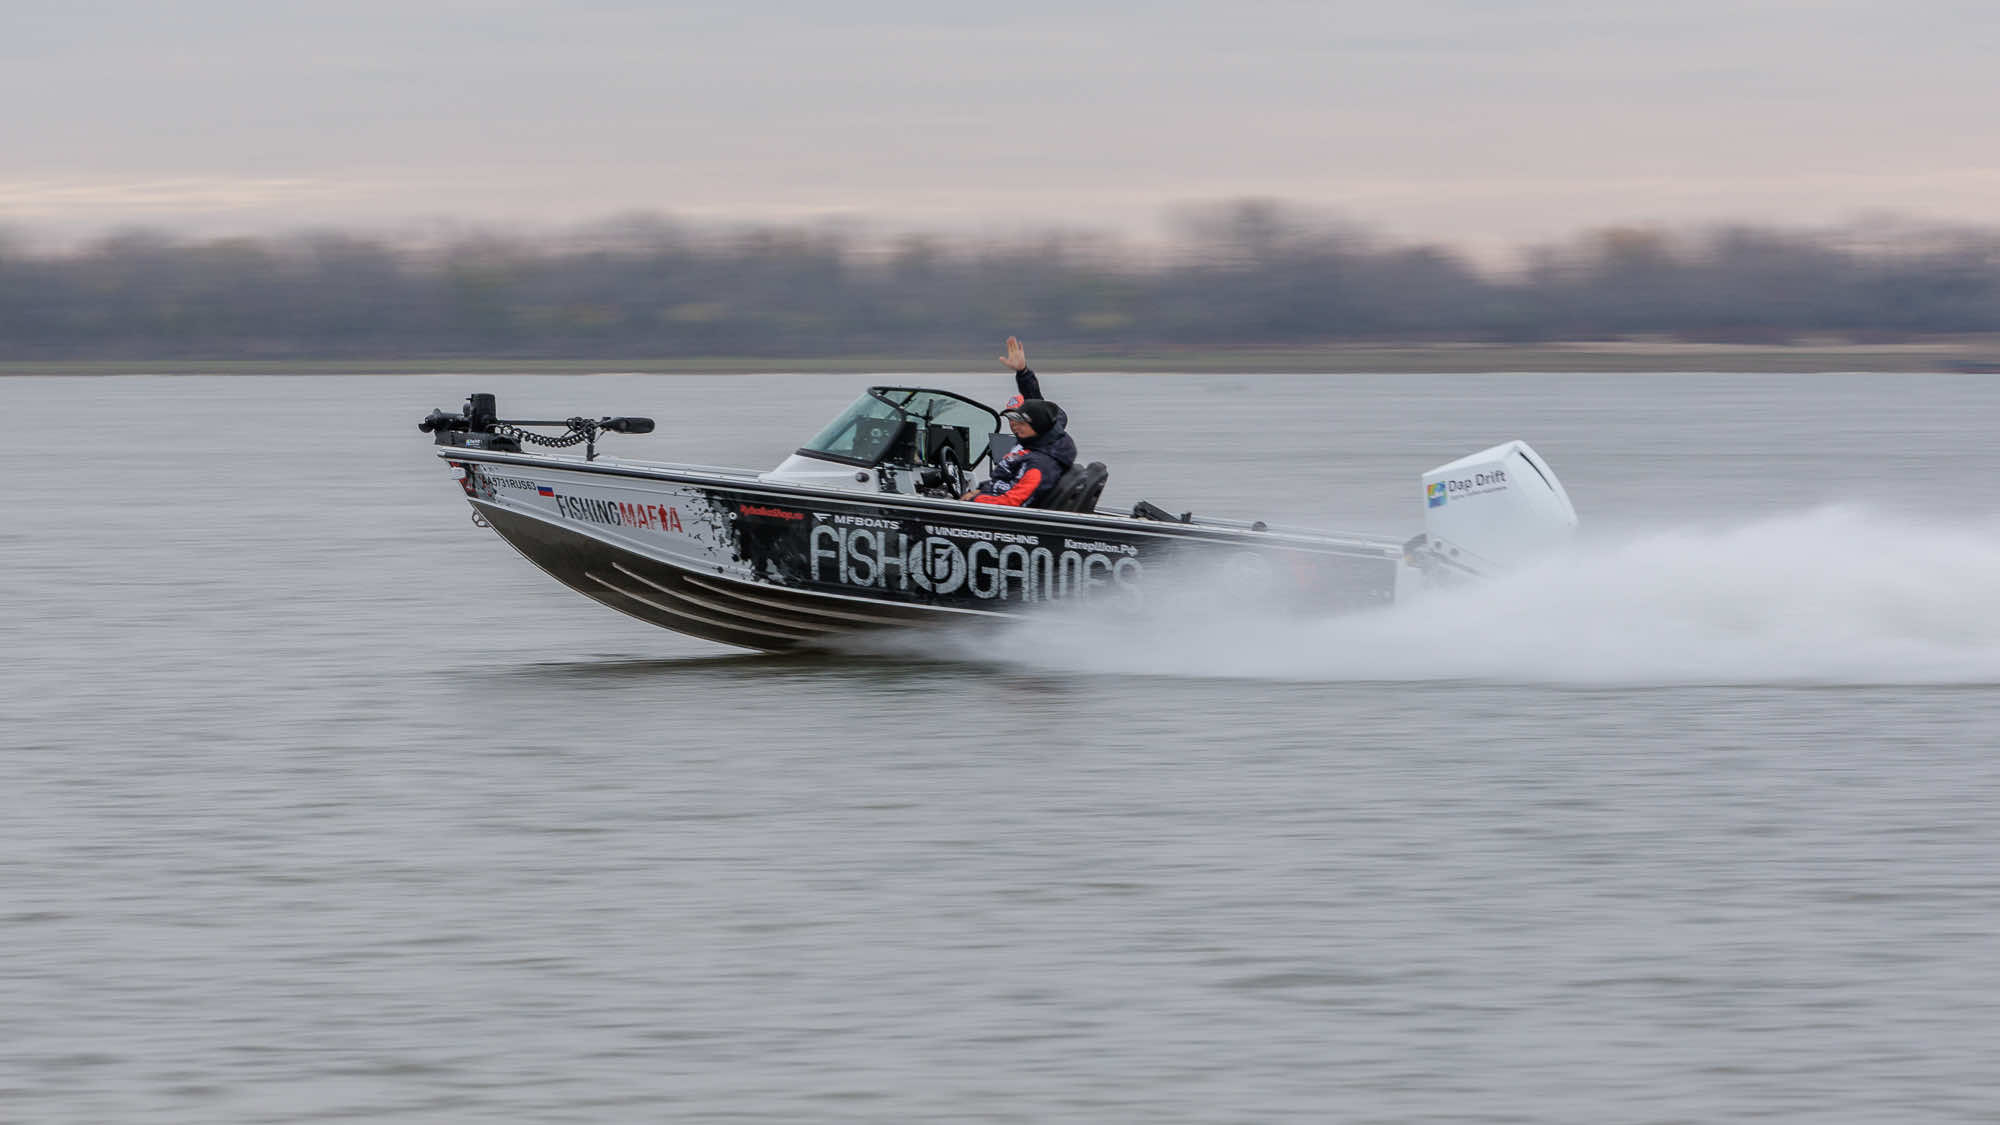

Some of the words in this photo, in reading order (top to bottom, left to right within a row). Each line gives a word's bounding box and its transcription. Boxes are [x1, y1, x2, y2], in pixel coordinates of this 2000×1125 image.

[1448, 479, 1473, 493] Dap
[1475, 470, 1507, 486] Drift
[833, 514, 900, 530] MFBOATS
[993, 532, 1039, 545] FISHING
[810, 525, 908, 591] FISH
